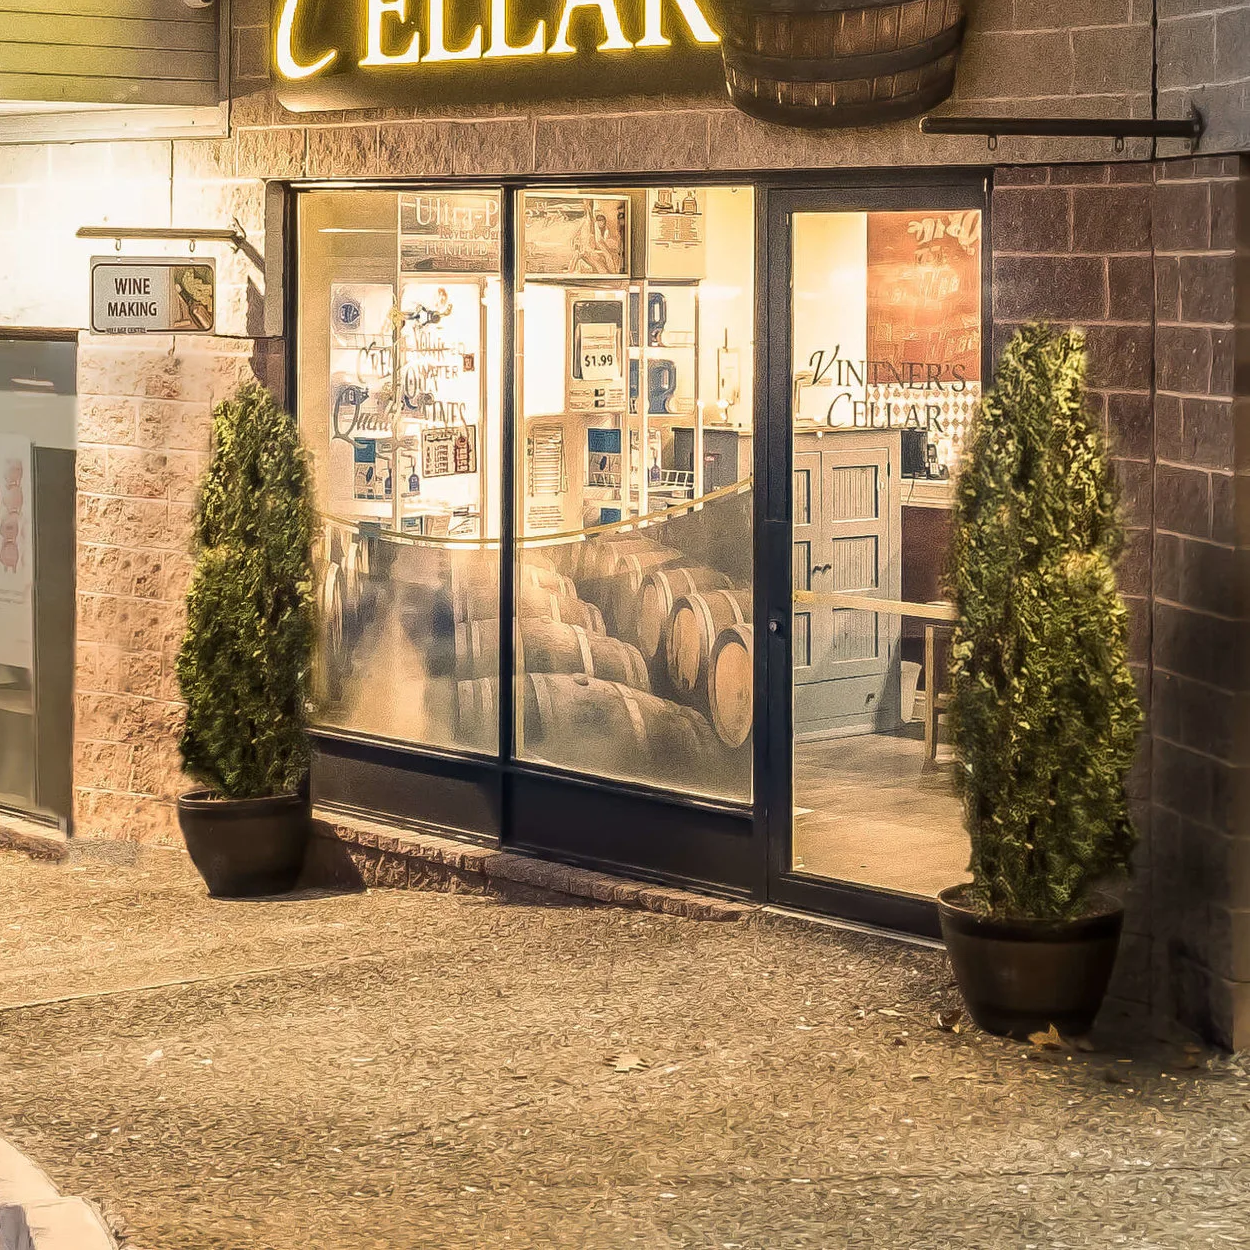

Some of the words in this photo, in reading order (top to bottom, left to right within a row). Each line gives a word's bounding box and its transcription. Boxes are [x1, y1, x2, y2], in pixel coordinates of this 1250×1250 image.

[114, 277, 151, 295] WINE
[107, 301, 158, 317] MAKING
[584, 354, 613, 367] $1.99
[809, 344, 966, 392] VINTNER'S
[826, 392, 943, 433] CELLAR
